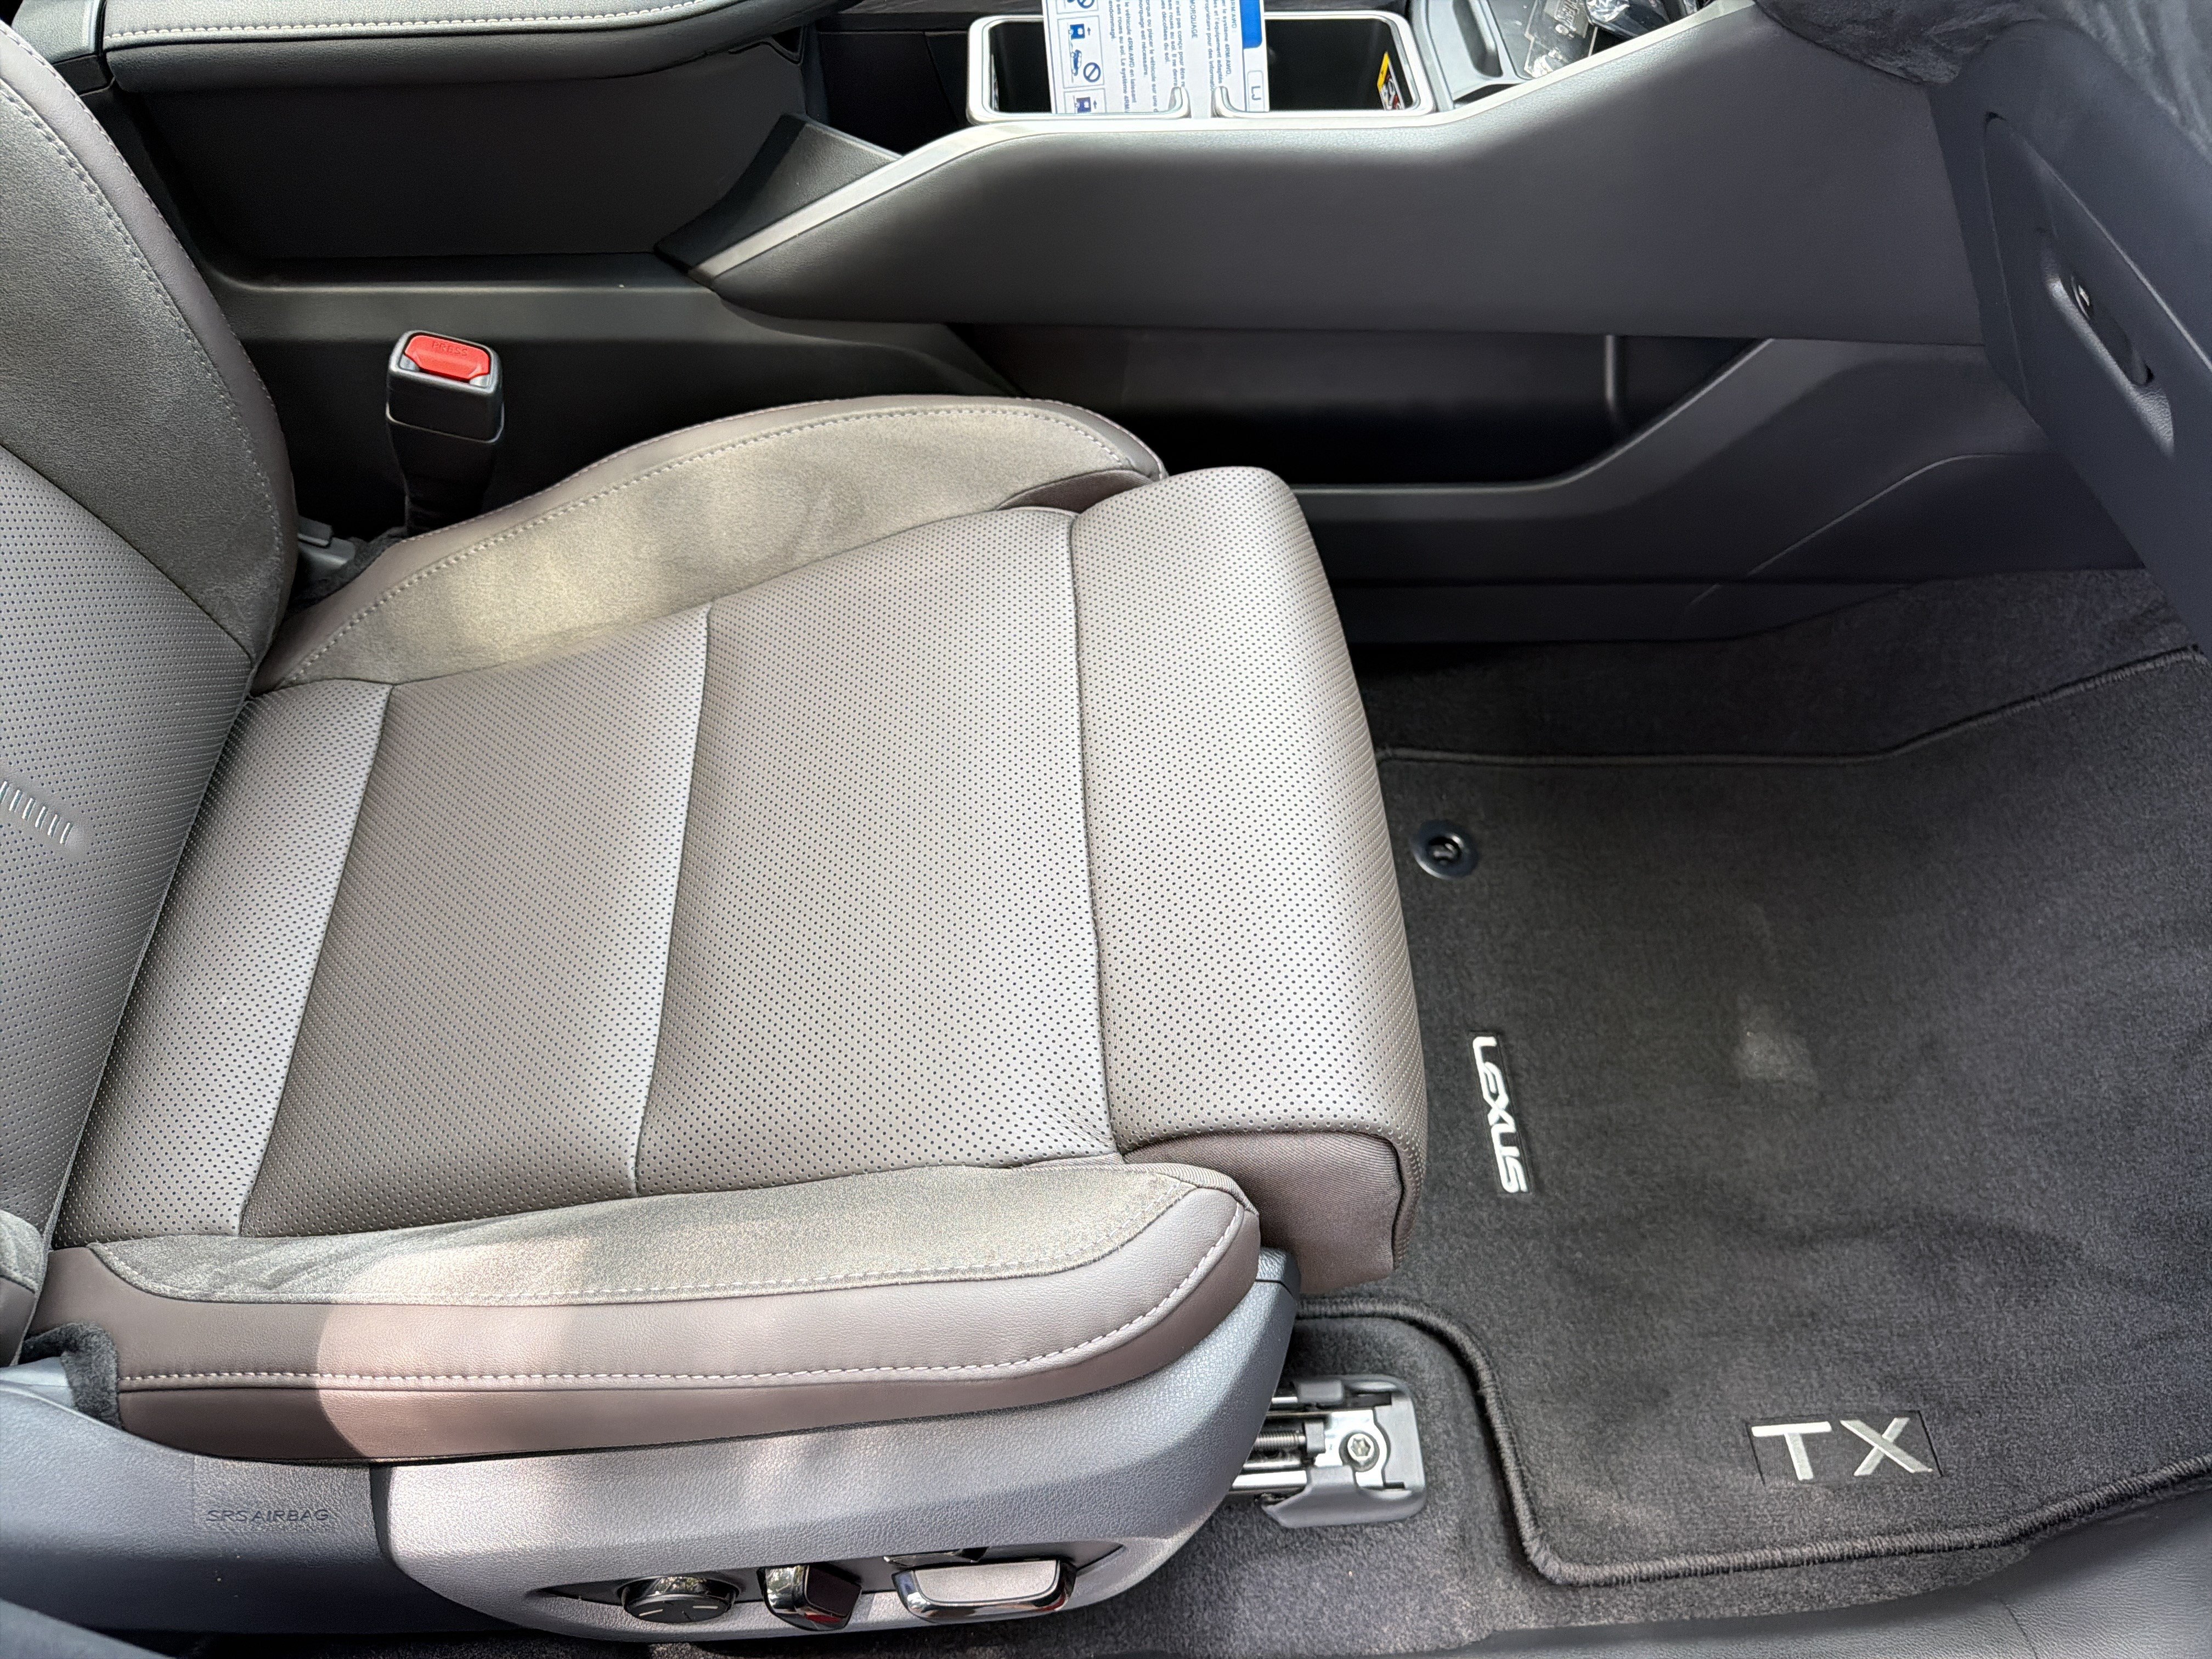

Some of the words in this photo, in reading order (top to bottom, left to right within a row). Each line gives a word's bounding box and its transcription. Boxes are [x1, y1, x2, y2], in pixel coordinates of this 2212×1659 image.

[1164, 43, 1169, 51] du
[1130, 69, 1135, 77] en
[1251, 86, 1261, 100] LJ
[431, 340, 469, 357] PRESS
[1472, 1036, 1528, 1194] LEXUS
[1751, 1417, 1933, 1481] TX
[206, 1510, 248, 1522] SRS
[251, 1509, 330, 1522] AIRBAG
